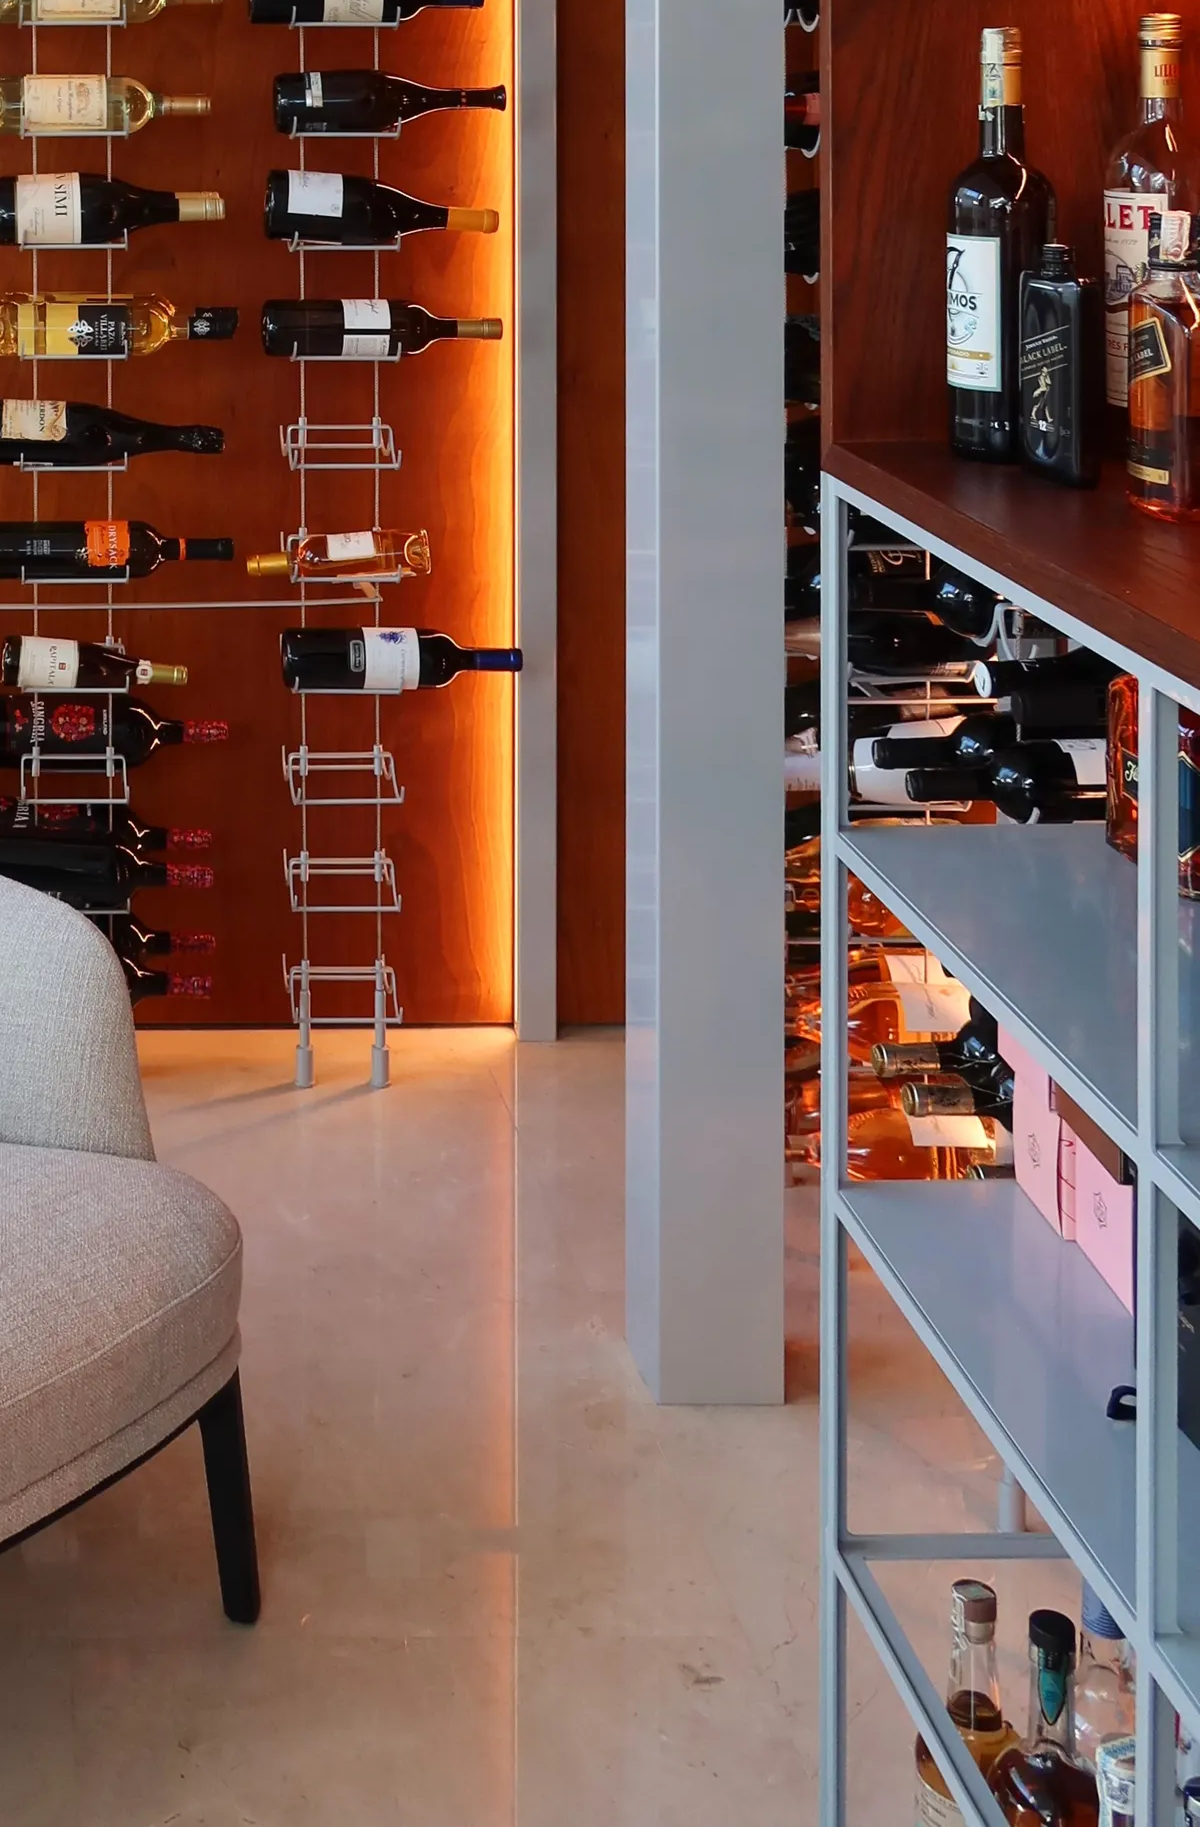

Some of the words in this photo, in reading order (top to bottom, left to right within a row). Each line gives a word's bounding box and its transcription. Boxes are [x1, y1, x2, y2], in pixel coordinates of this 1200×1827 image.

[54, 184, 68, 217] SIMI
[1105, 202, 1155, 231] LET
[948, 292, 977, 311] MOS
[29, 700, 46, 744] SANGRIA
